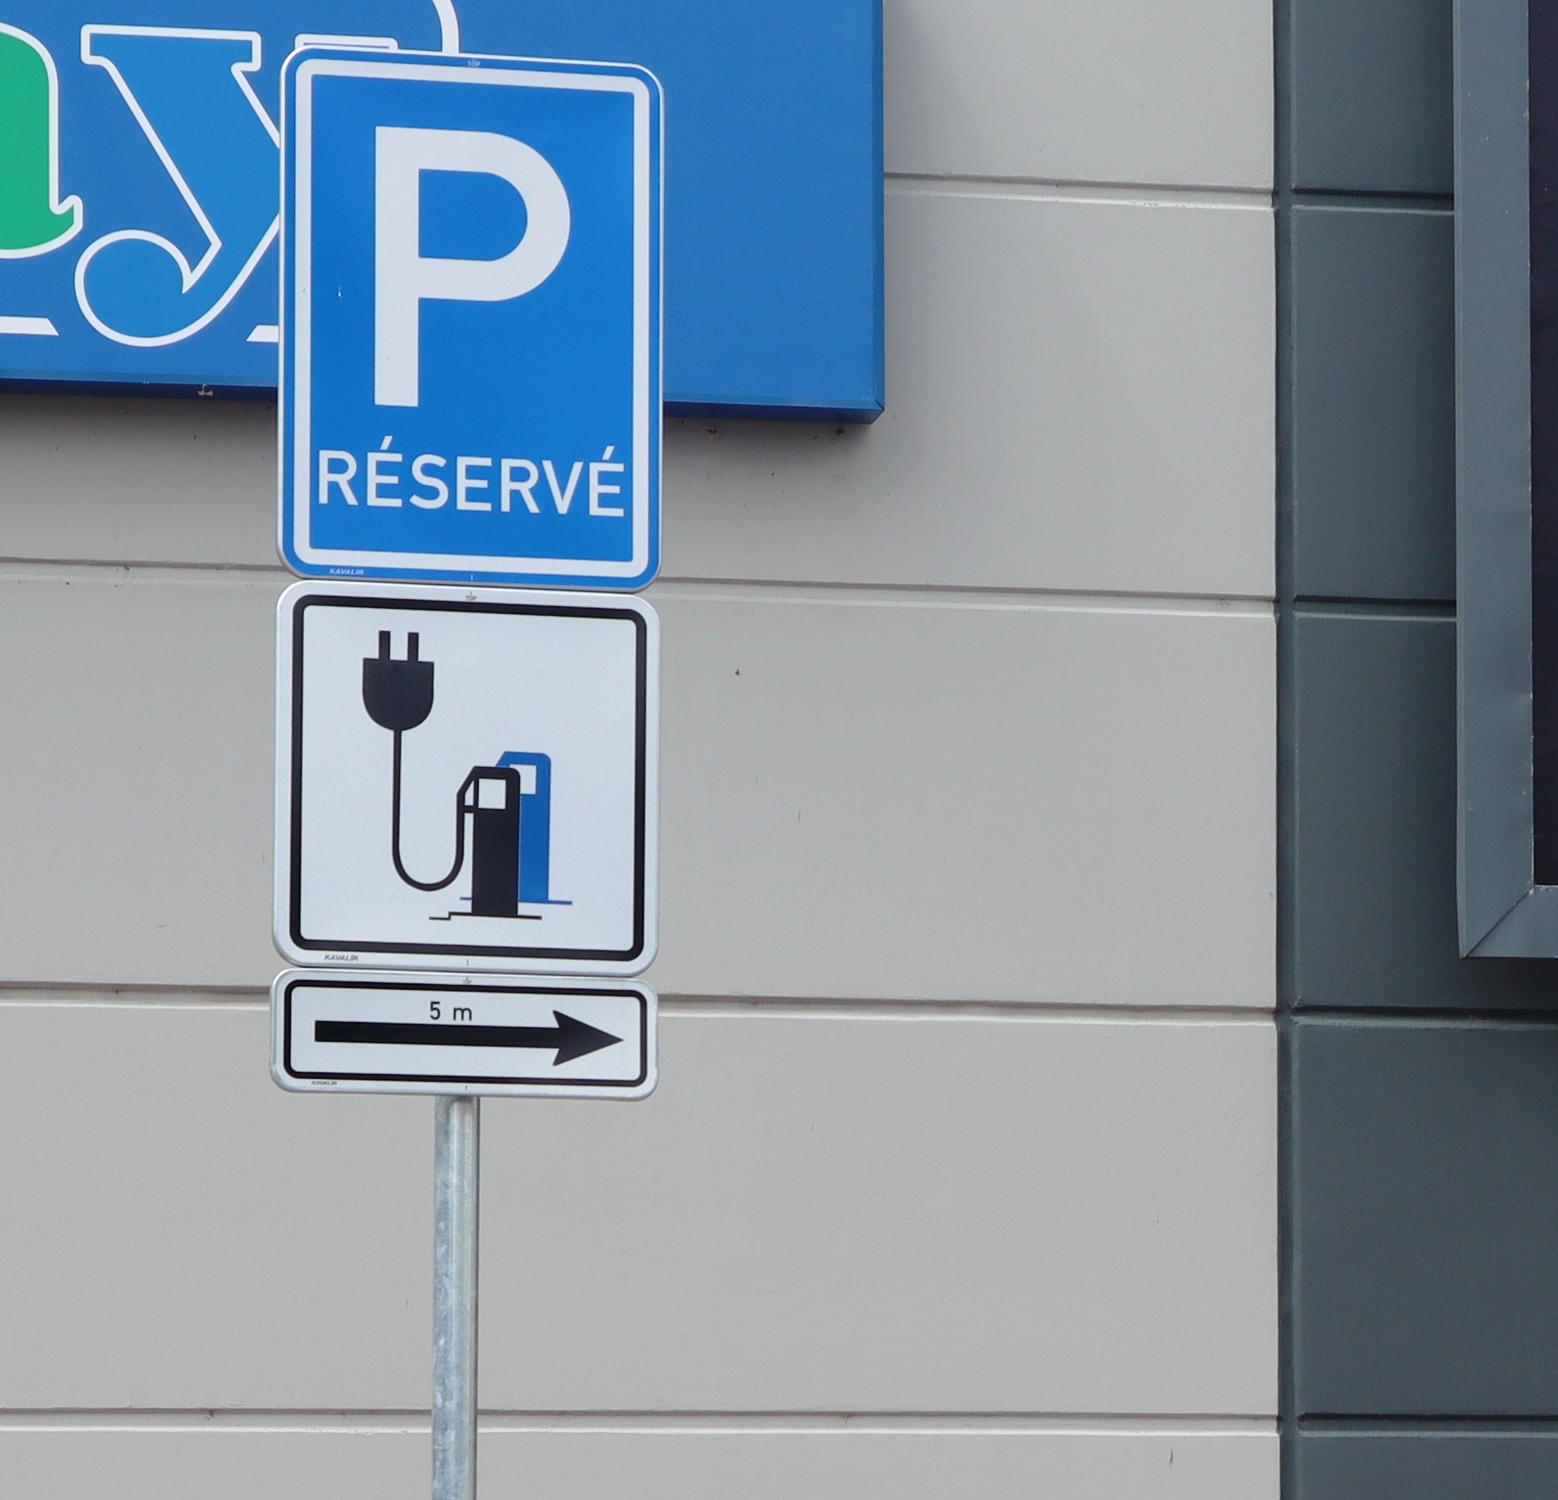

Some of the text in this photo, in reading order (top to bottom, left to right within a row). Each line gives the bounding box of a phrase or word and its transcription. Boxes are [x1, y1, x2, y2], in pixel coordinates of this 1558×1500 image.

[374, 126, 571, 408] P
[318, 435, 625, 518] RÉSERVÉ
[429, 1000, 473, 1022] 5 m
